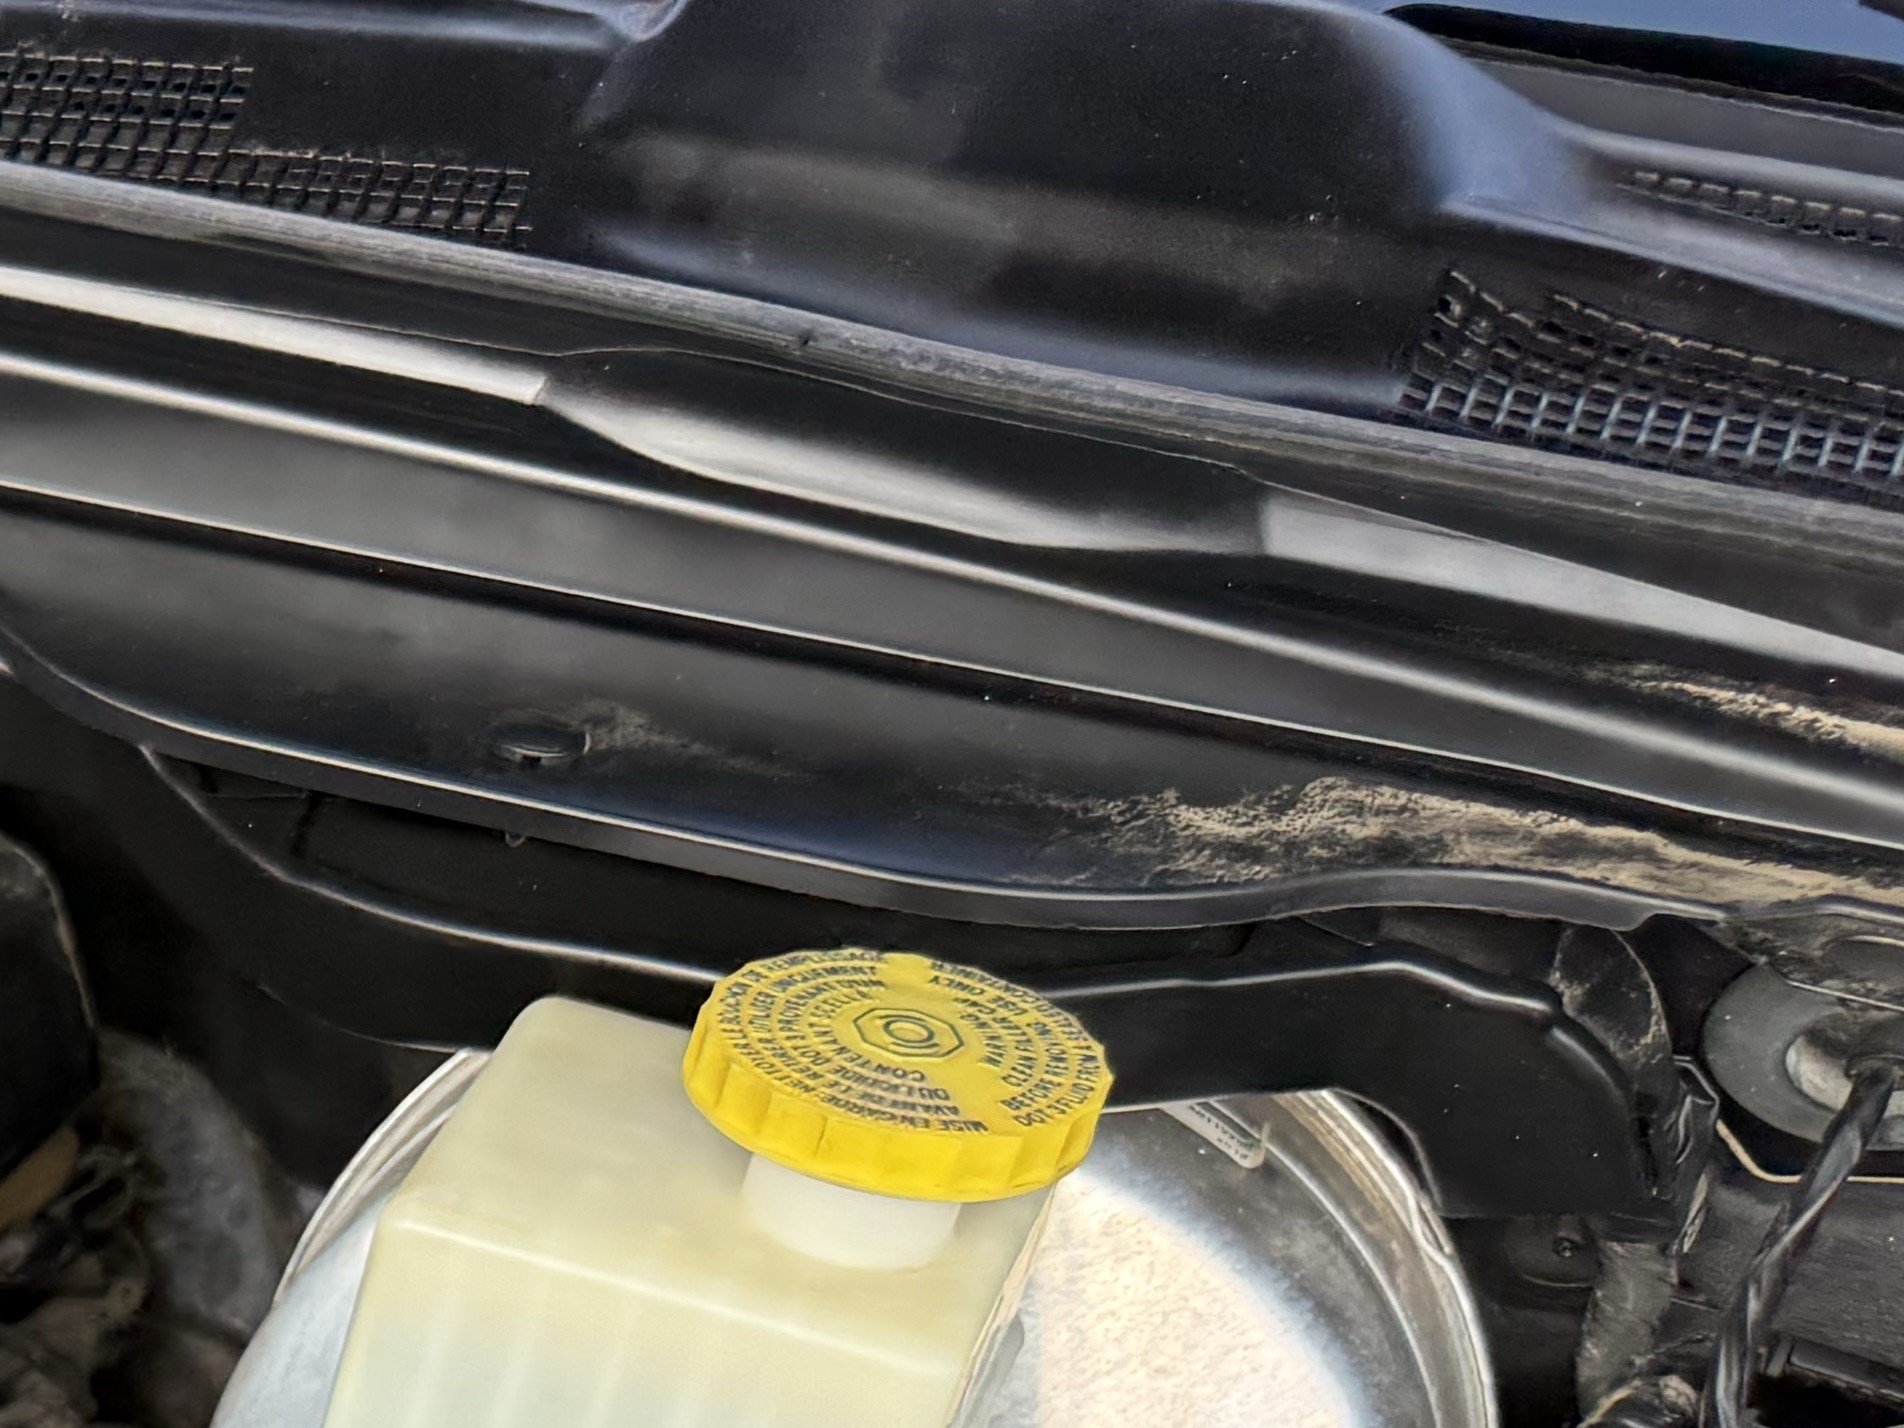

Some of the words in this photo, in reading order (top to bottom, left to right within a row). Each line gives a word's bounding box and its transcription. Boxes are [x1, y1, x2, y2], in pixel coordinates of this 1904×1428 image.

[931, 976, 985, 995] ONLY
[988, 996, 1028, 1014] USE
[722, 1027, 746, 1039] LE
[784, 1033, 805, 1041] 3
[988, 1016, 1036, 1050] FILLER
[791, 1046, 831, 1064] DOT
[733, 1044, 814, 1094] NETTOYER
[999, 1056, 1035, 1086] CLEAN
[1075, 1054, 1097, 1081] FROM
[920, 1087, 951, 1101] DU
[1000, 1078, 1060, 1110] BEFORE
[1055, 1083, 1093, 1108] FLUID
[1012, 1109, 1055, 1125] DOT
[1045, 1103, 1067, 1115] 3
[901, 1115, 928, 1129] EN
[937, 1119, 987, 1132] MISE
